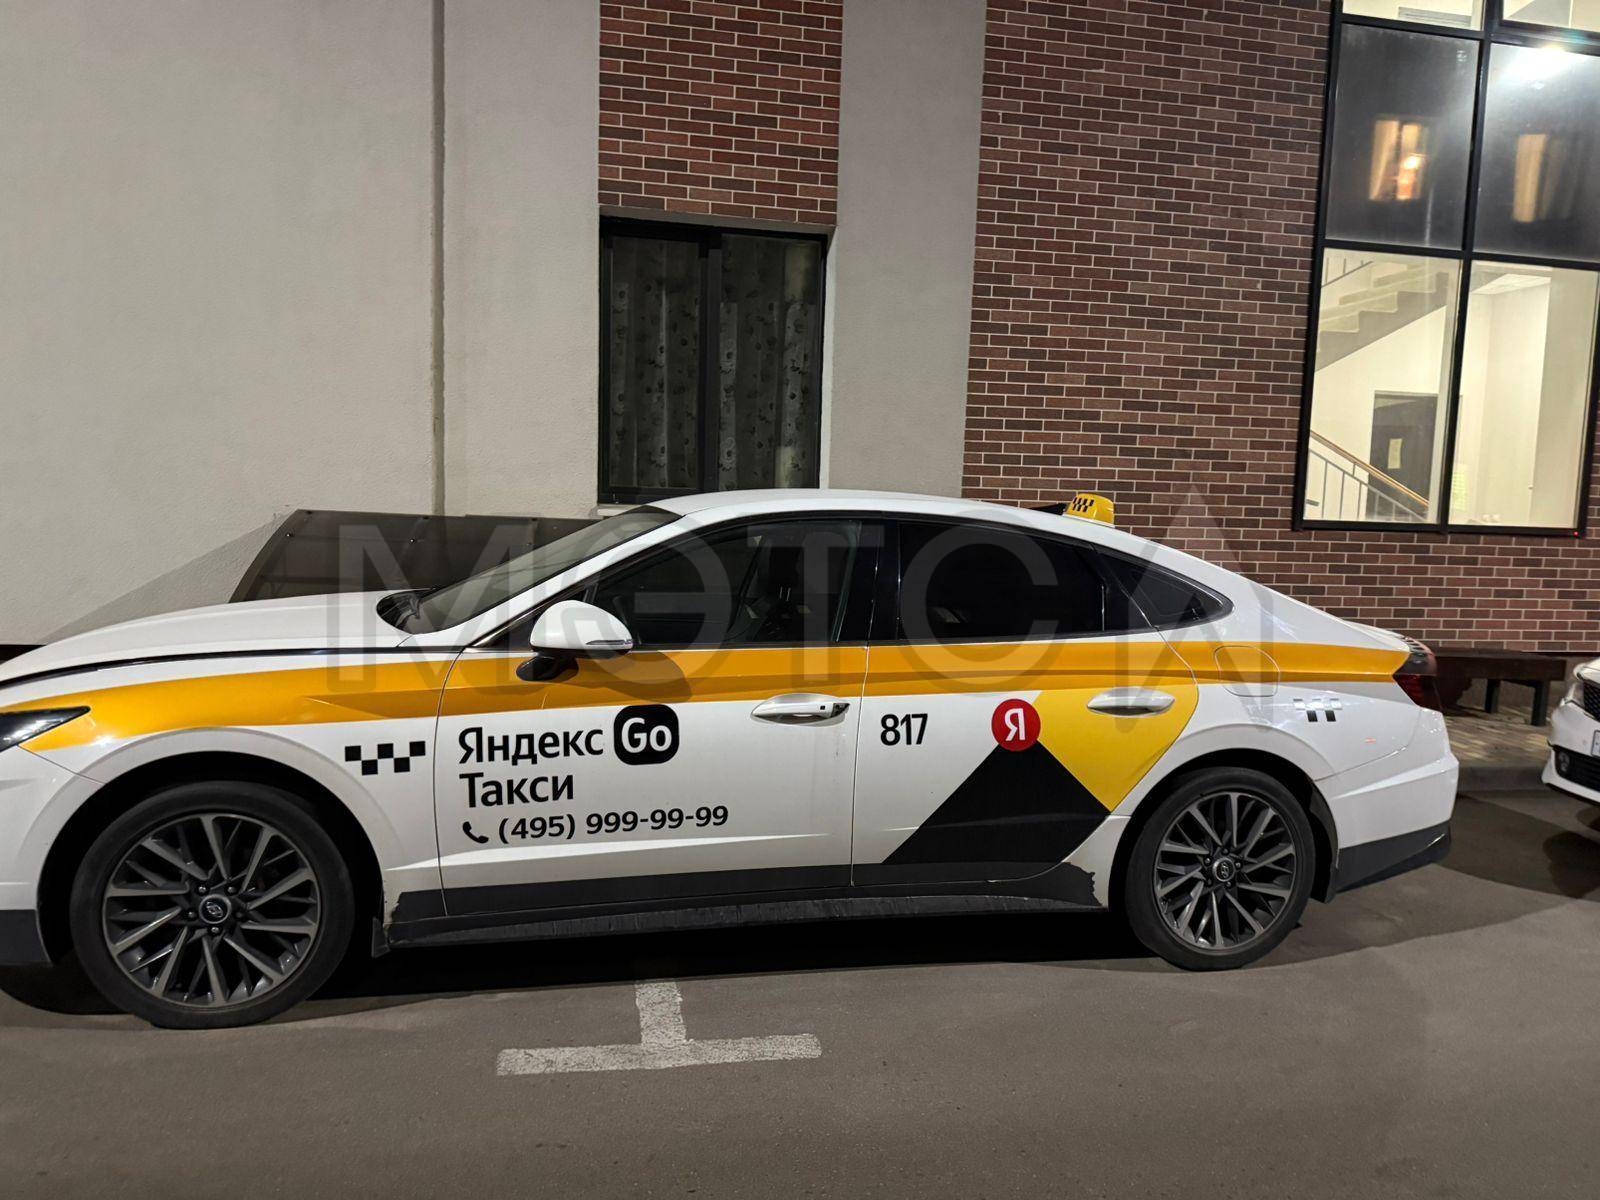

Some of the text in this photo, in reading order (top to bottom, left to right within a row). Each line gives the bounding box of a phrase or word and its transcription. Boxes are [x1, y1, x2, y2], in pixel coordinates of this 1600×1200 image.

[457, 716, 673, 766] Яндекс Go
[880, 713, 929, 746] 817
[1003, 707, 1027, 742] Я
[458, 772, 575, 808] Такси
[498, 804, 730, 844] (495) 999-99-99
